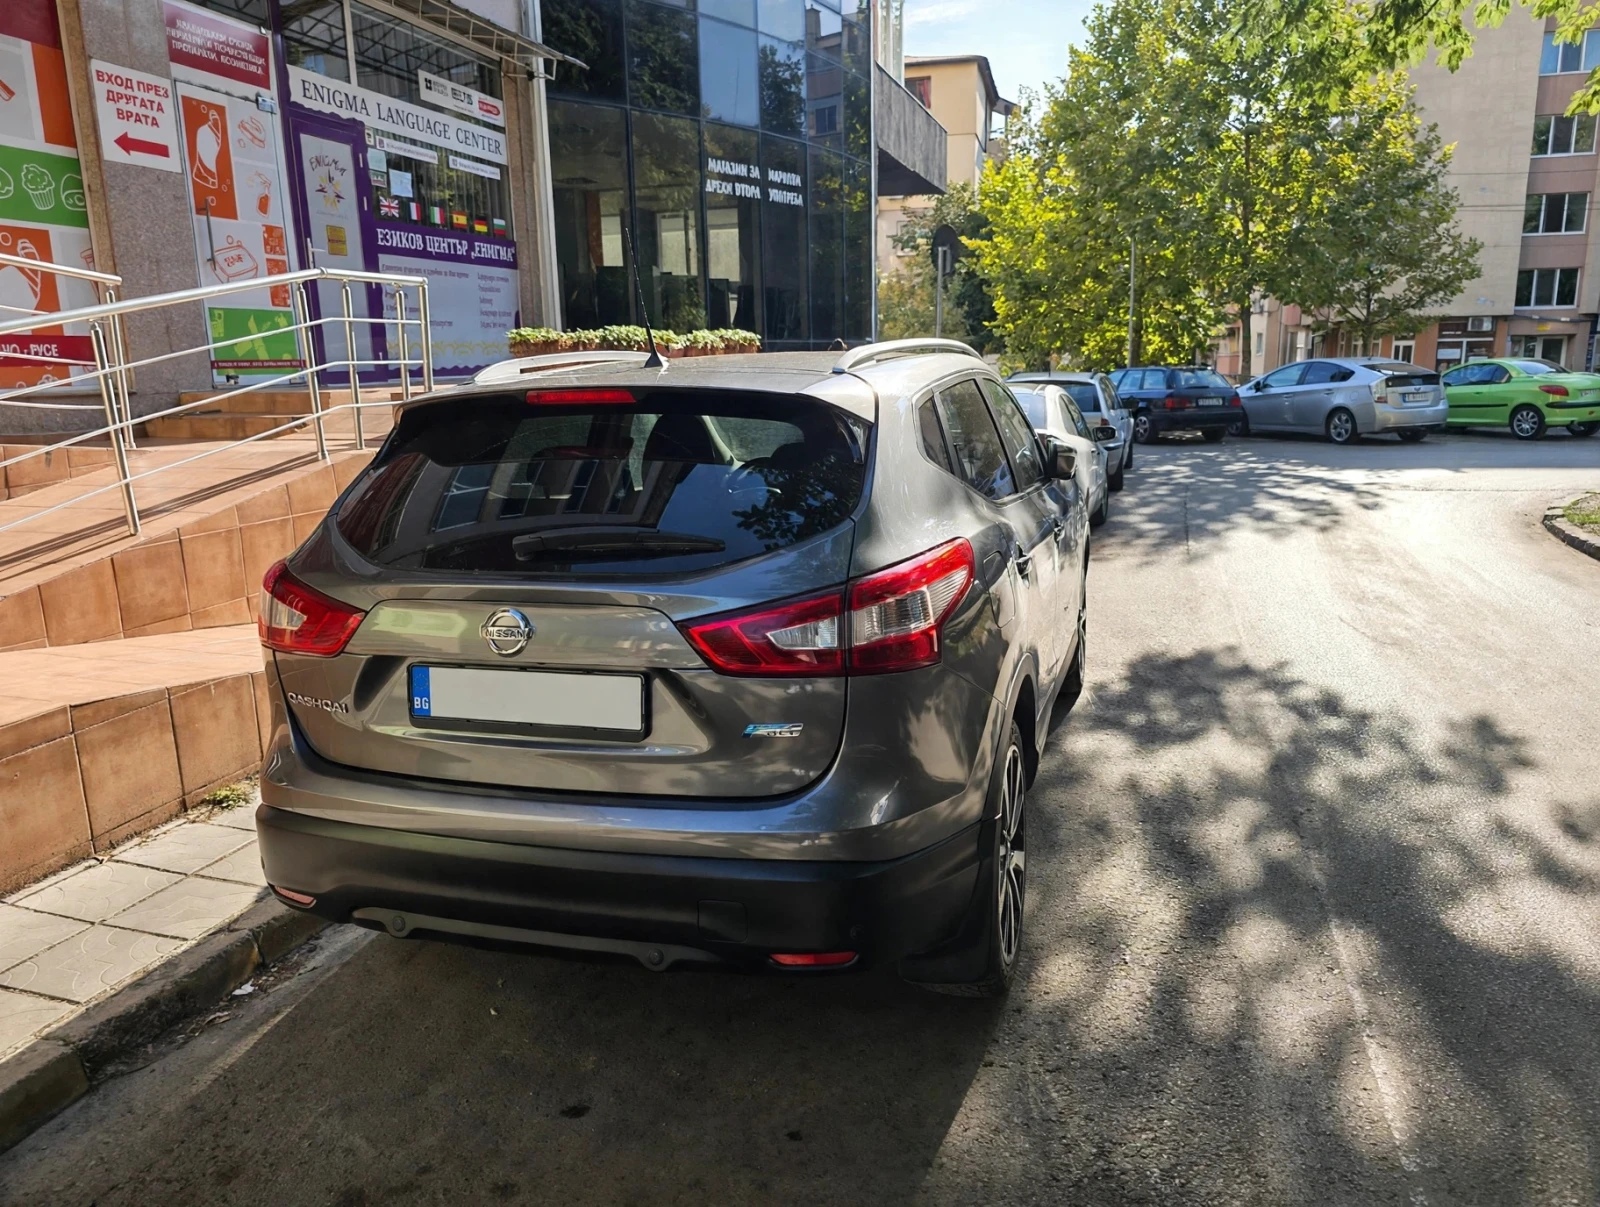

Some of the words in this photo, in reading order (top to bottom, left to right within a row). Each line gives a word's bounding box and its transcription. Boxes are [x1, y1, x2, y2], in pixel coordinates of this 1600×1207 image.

[95, 69, 134, 92] ВХОД
[136, 80, 169, 98] ПРЕЗ
[106, 89, 165, 114] ДРУГАТА
[116, 108, 160, 128] ВРАТА
[301, 79, 370, 116] ENIGMA
[376, 102, 450, 140] LANGUAGE
[456, 127, 503, 156] CENTER
[376, 228, 424, 251] ЕЗИКОВ
[425, 235, 469, 256] ЦЕНТЪР
[486, 628, 526, 638] NISSAN
[287, 692, 348, 714] QASHQAI
[413, 696, 429, 710] BG
